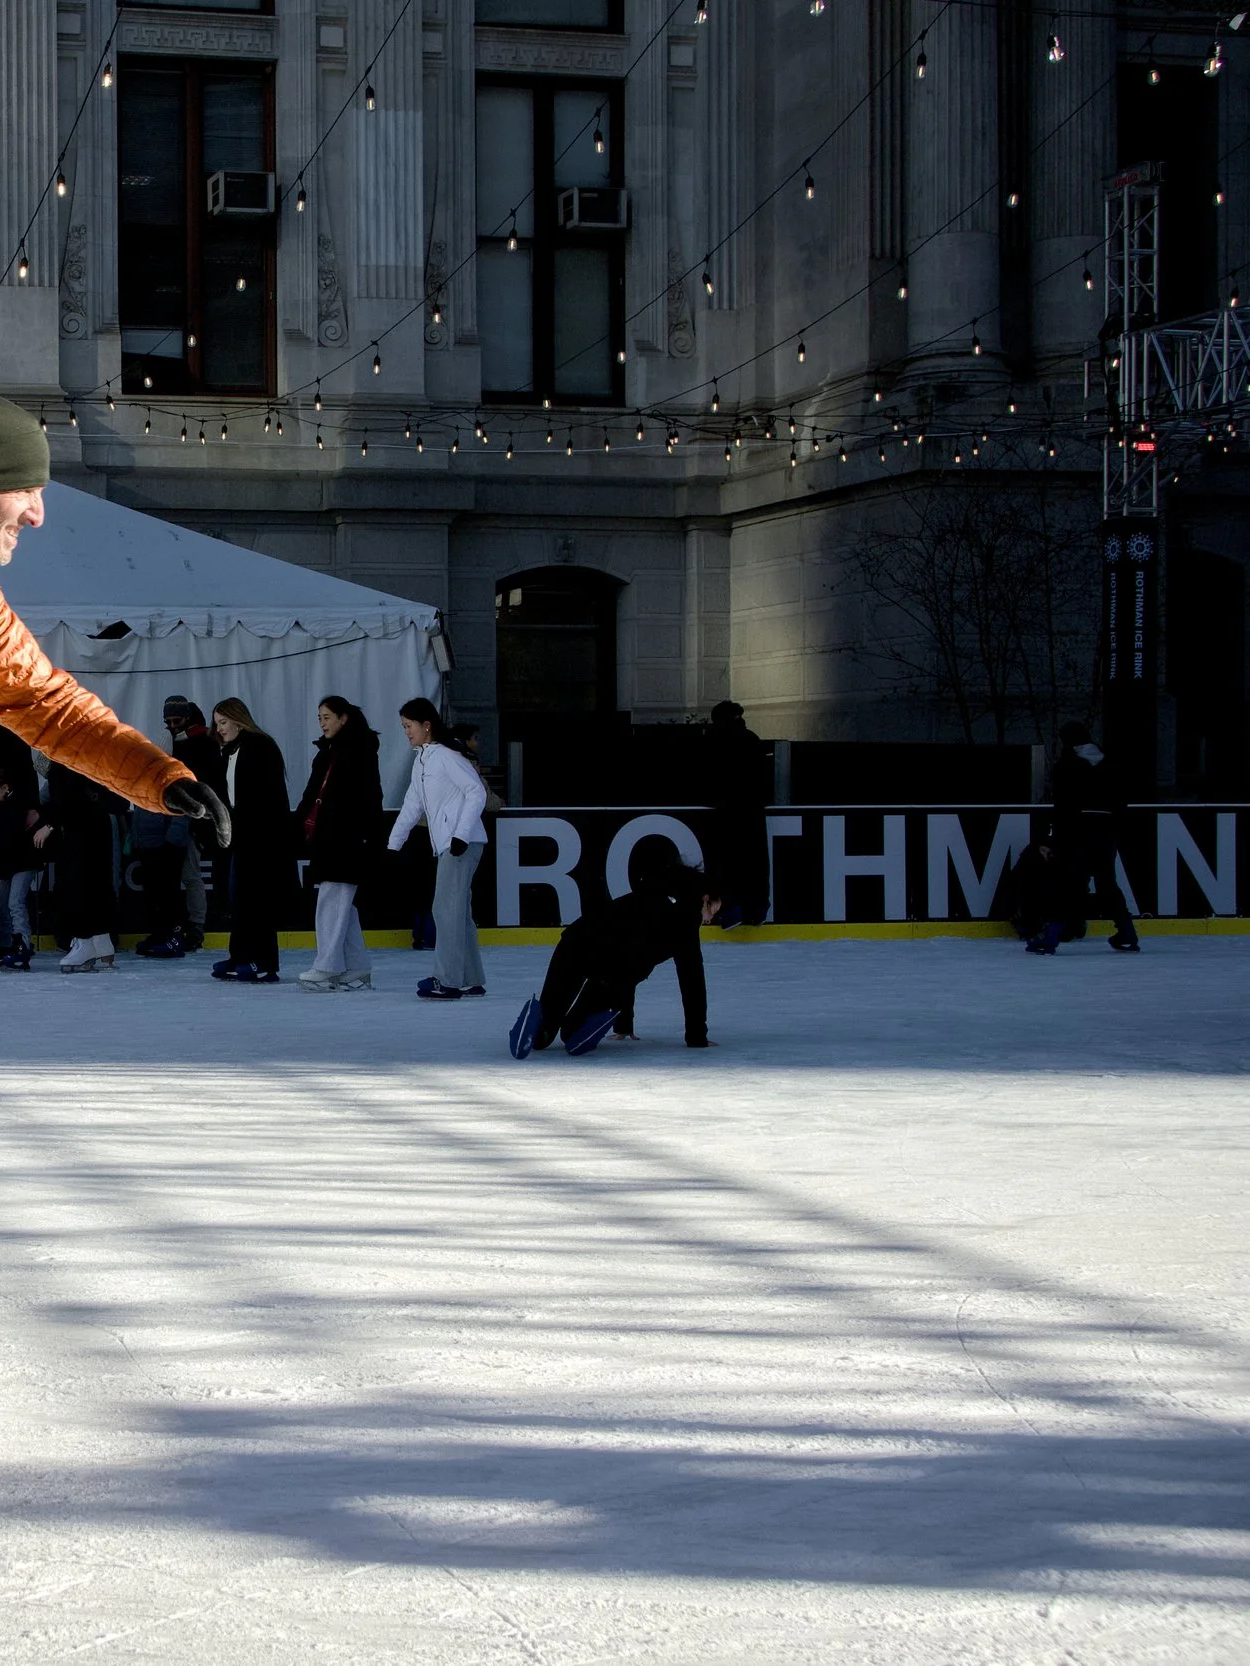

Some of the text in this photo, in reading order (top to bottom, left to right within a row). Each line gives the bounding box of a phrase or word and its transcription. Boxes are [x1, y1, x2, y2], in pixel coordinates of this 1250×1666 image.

[1110, 572, 1118, 629] ROTHMAN
[1133, 570, 1145, 680] ROTHMAN ICE RINK
[495, 812, 1238, 927] ROHMN
